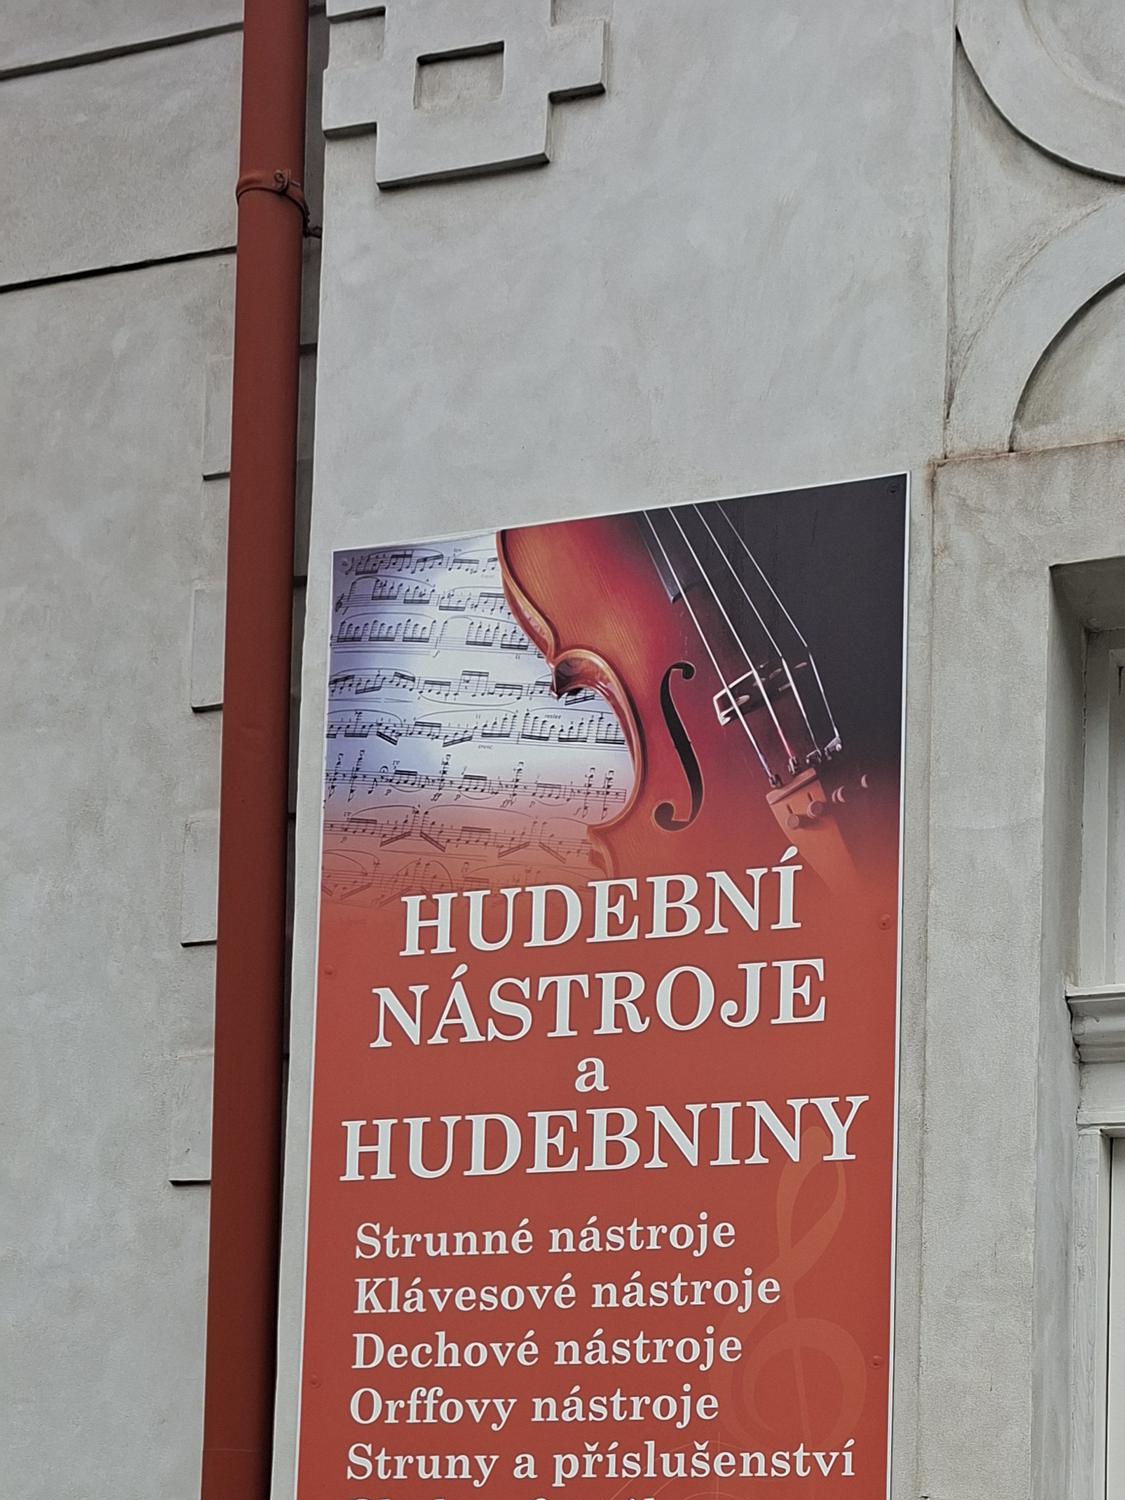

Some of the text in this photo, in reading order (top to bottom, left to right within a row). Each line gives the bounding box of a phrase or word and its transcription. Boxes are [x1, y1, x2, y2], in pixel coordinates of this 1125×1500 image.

[399, 845, 803, 957] HUDEBNÍ
[369, 958, 826, 1049] NÁSTROJE
[574, 1057, 610, 1093] a
[339, 1095, 870, 1182] HUDEBNINY
[355, 1211, 736, 1259] Strunné nástroje
[353, 1268, 781, 1314] Klávesové nástroje
[351, 1325, 742, 1372] Dechové nástroje
[349, 1384, 719, 1432] Orffovy nástroje
[346, 1438, 856, 1488] Struny a příslušenství
